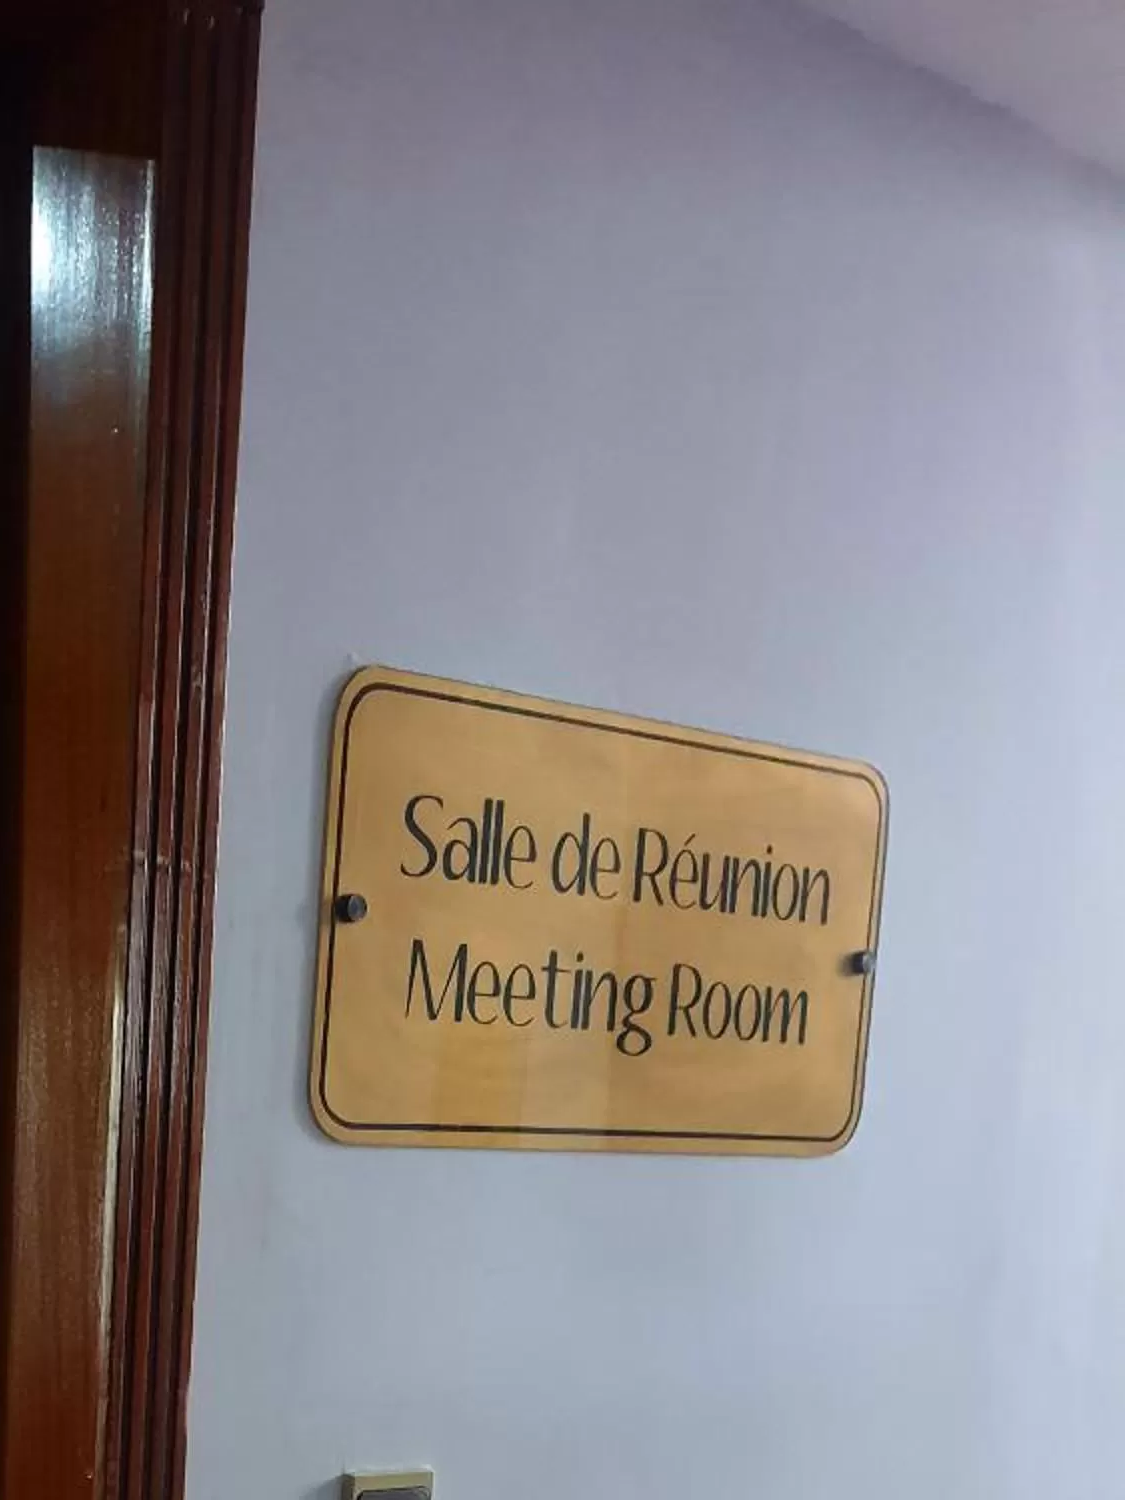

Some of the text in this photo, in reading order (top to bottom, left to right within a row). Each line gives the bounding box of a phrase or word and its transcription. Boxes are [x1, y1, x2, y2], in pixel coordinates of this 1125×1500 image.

[399, 793, 831, 925] Salle de Réunion
[404, 938, 810, 1057] Meeting Room
